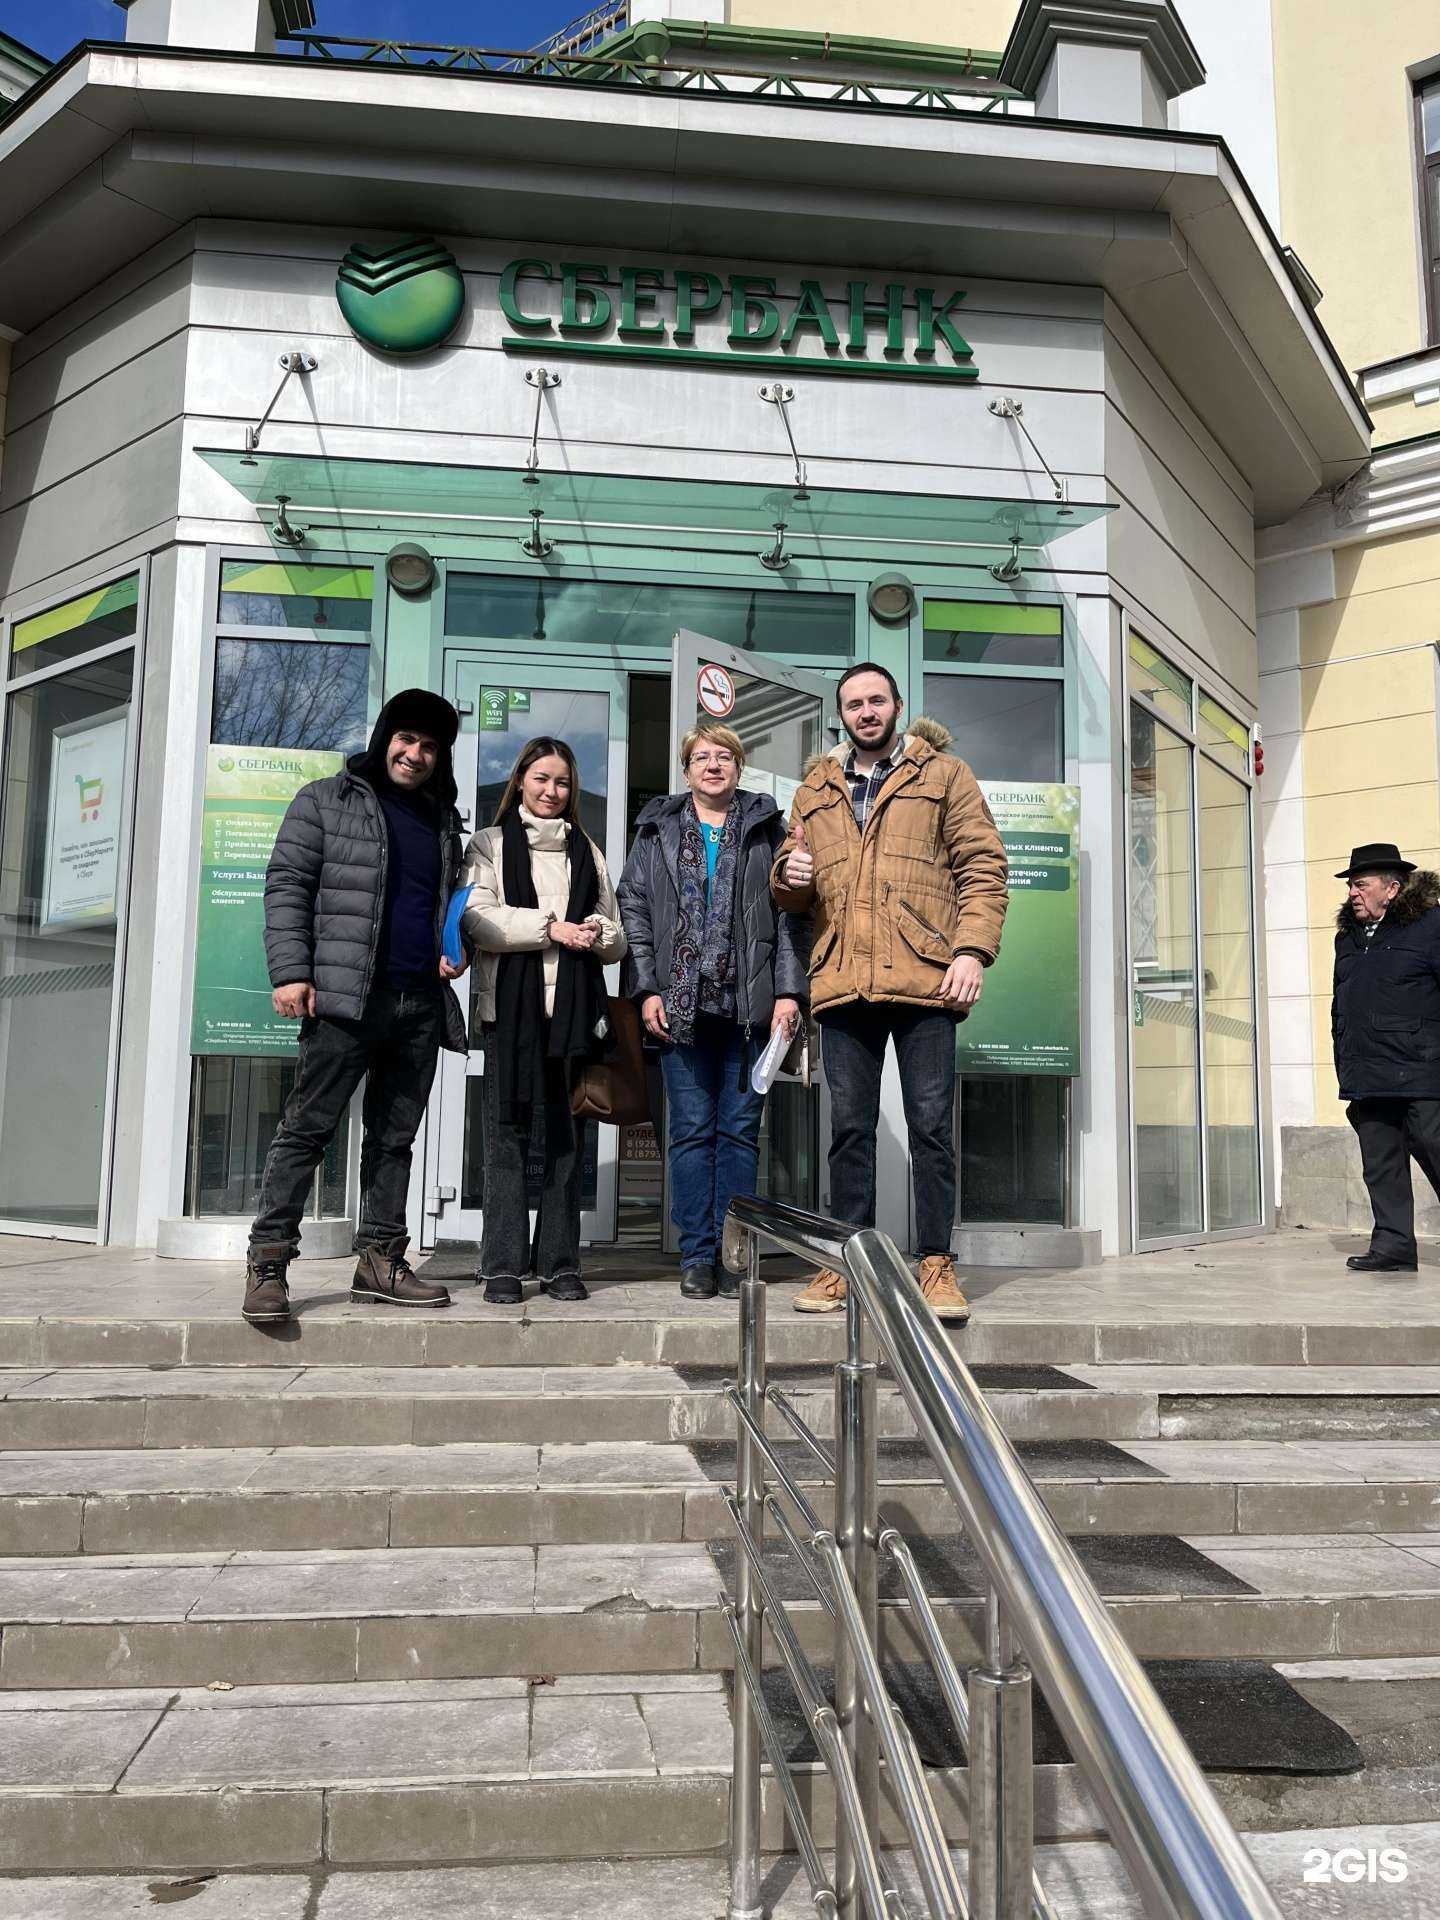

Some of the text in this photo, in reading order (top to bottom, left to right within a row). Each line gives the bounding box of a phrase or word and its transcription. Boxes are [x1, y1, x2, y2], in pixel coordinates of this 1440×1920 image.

[499, 258, 974, 361] СБЕРБАНК
[238, 758, 303, 772] СБЕРБАНК
[988, 792, 1046, 804] СБЕРБАНК
[225, 819, 274, 830] Оплата услуг
[1024, 845, 1064, 853] клиентов
[212, 870, 267, 881] Услуги Бан
[1008, 870, 1048, 878] отечного
[211, 897, 246, 905] клиентов
[627, 1129, 657, 1138] ОТДЕ
[635, 1139, 657, 1148] (928
